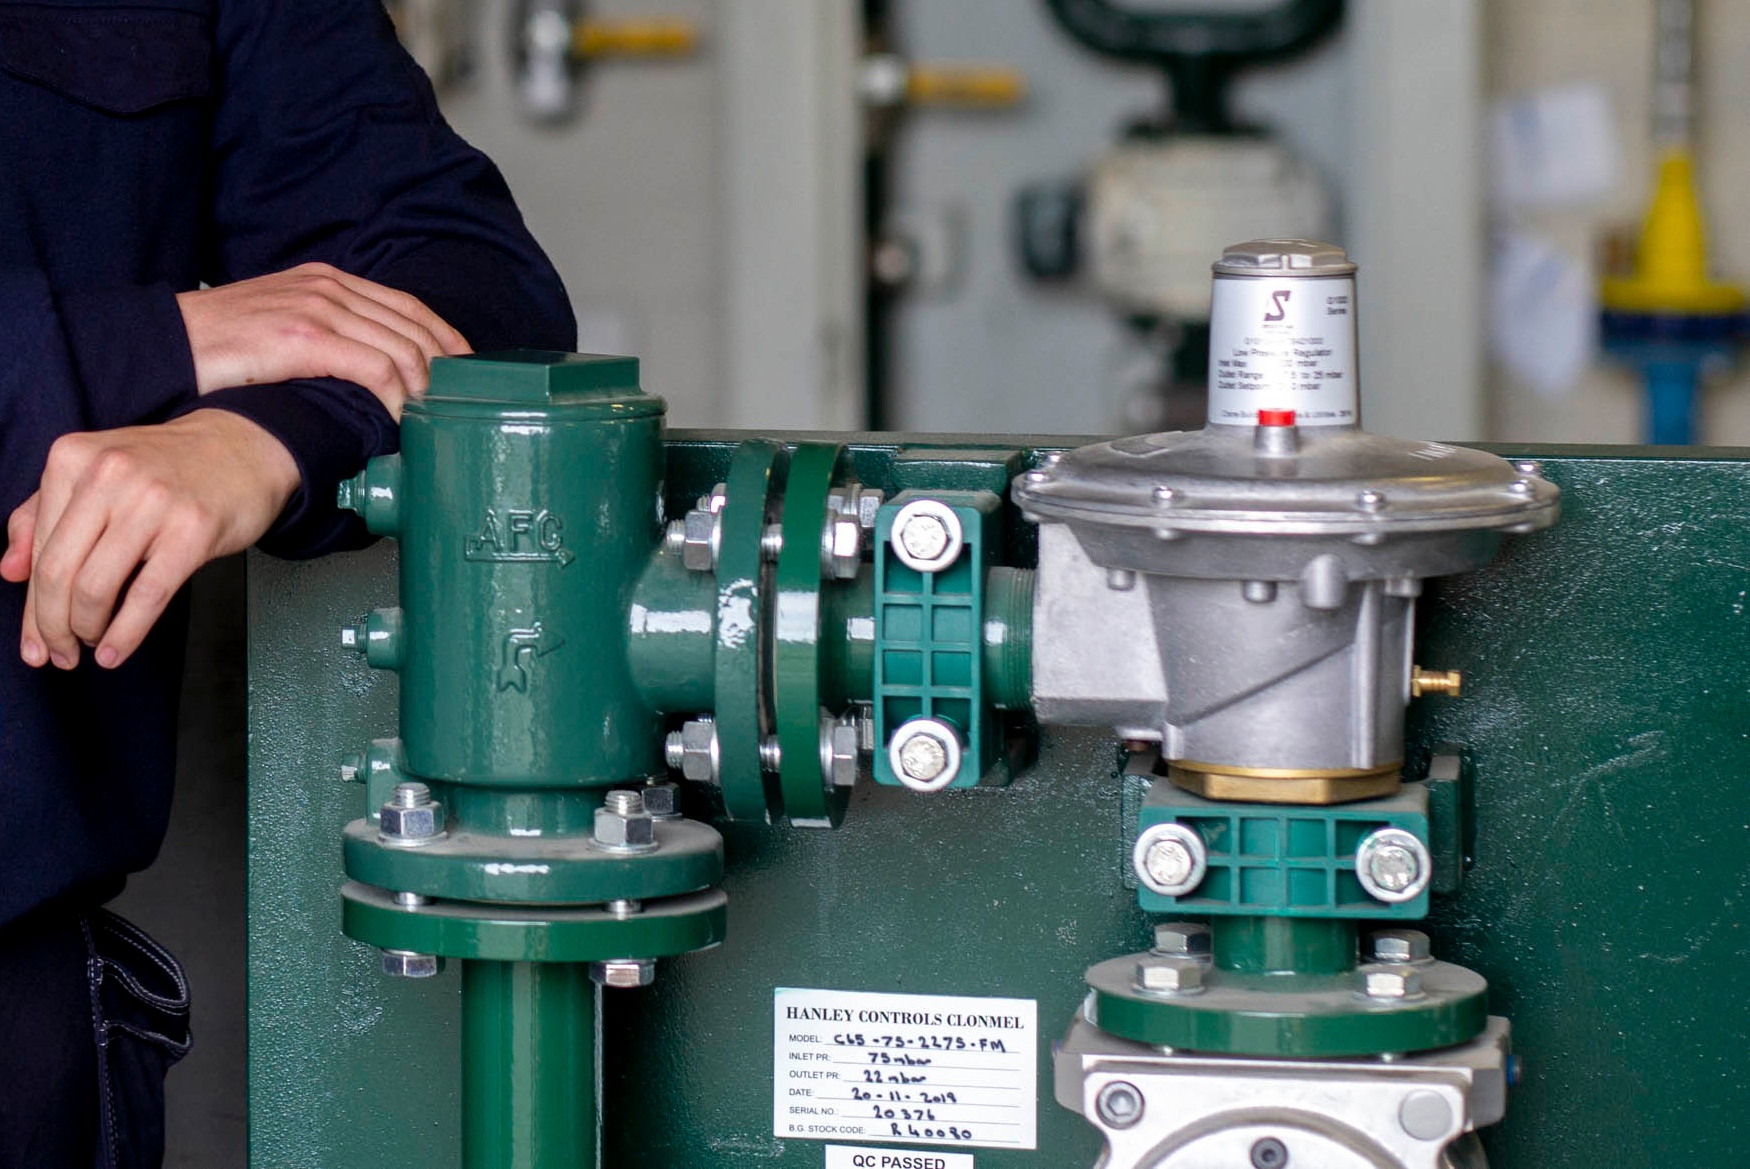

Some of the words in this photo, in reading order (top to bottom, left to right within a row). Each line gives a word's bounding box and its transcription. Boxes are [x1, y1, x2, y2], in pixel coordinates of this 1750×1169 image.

[786, 1006, 854, 1022] HANLEY
[858, 1009, 942, 1026] CONTROLS
[946, 1013, 1025, 1030] CLONMEL
[789, 1034, 822, 1044] MODEL:
[789, 1052, 814, 1061] INLET
[816, 1053, 831, 1062] PR:
[789, 1070, 824, 1079] OUTLET
[826, 1071, 841, 1080] PR:
[789, 1088, 813, 1097] DATE:
[789, 1106, 818, 1115] SERIAL
[808, 1125, 838, 1134] STOCK
[839, 1126, 866, 1135] CODE:
[852, 1154, 876, 1168] QC
[881, 1156, 946, 1169] PASSED
